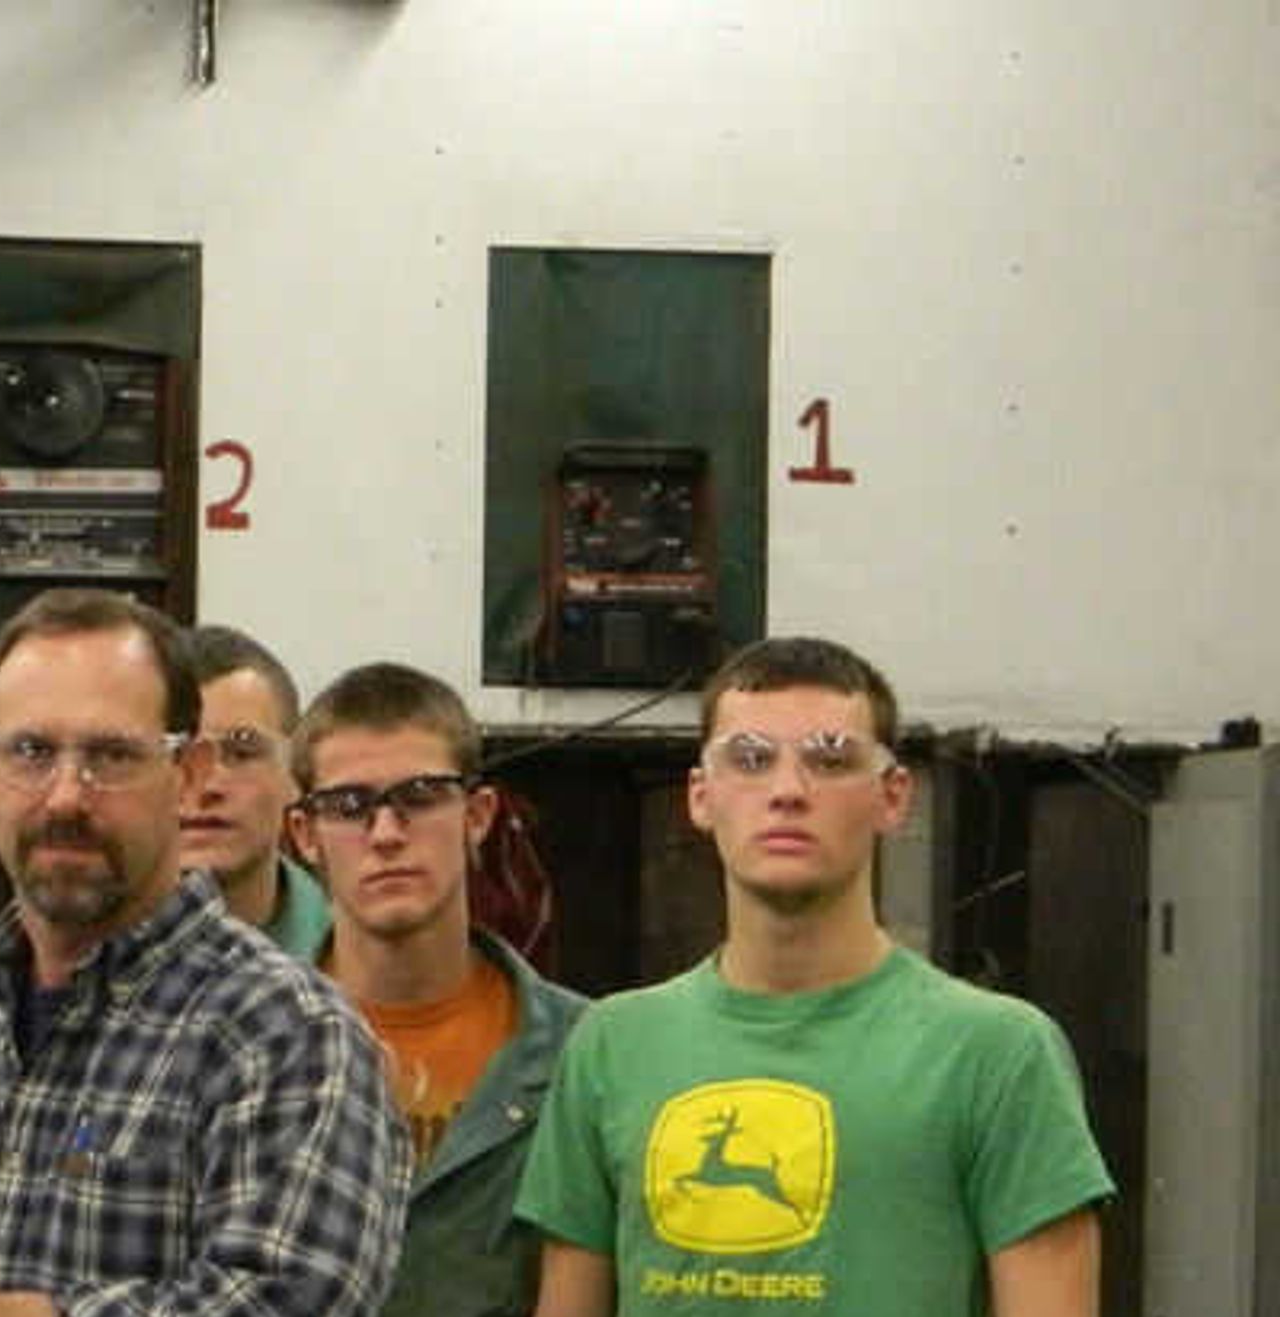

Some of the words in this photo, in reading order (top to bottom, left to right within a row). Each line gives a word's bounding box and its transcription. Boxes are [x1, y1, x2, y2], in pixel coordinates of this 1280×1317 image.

[204, 440, 253, 530] 2
[788, 399, 856, 485] 1
[714, 1269, 827, 1298] DEERE
